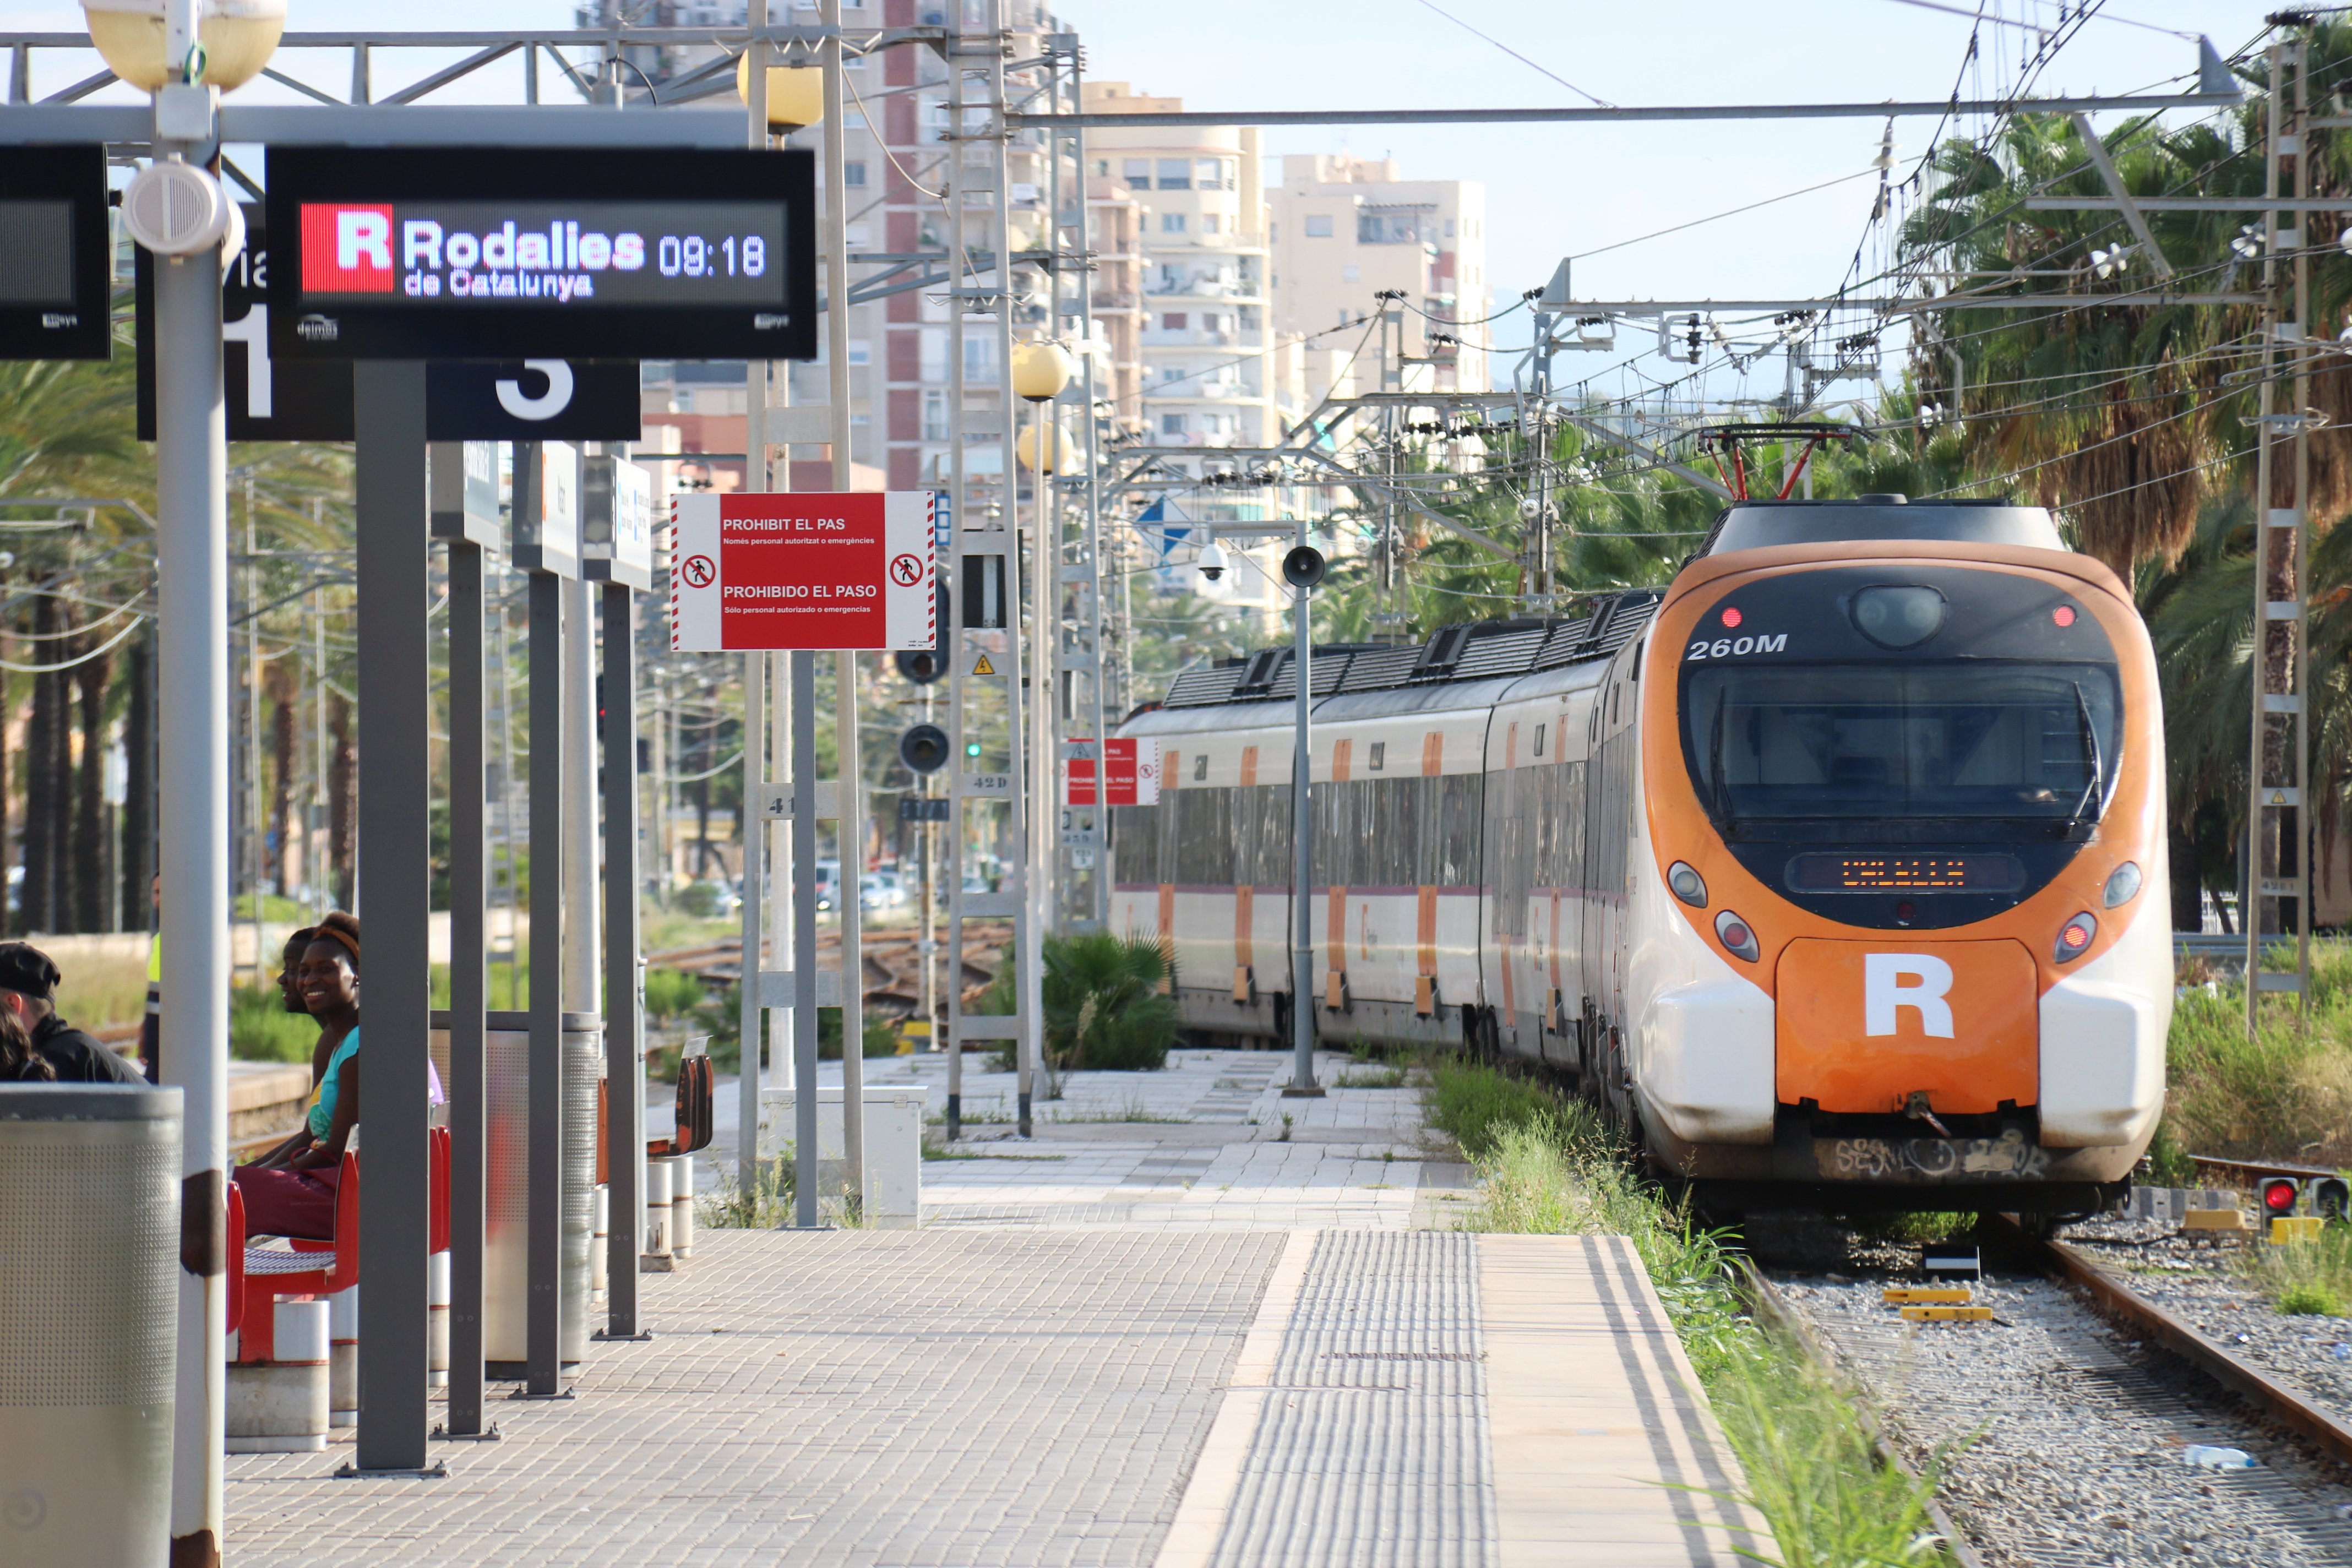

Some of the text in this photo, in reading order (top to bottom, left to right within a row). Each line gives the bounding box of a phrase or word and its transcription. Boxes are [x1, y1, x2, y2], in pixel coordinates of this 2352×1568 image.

[337, 210, 392, 270] R
[404, 220, 646, 270] Rodalies
[659, 235, 766, 277] 09:18
[404, 268, 594, 303] de Catalunya
[723, 518, 846, 531] PROHIBIT EL PAS
[750, 537, 783, 546] personal
[827, 536, 875, 546] emergències
[723, 585, 877, 598] PROHIBIDO EL PASO
[743, 606, 775, 614] personal
[824, 606, 871, 614] emergencias
[1687, 634, 1788, 661] 260M
[1865, 952, 1955, 1039] R
